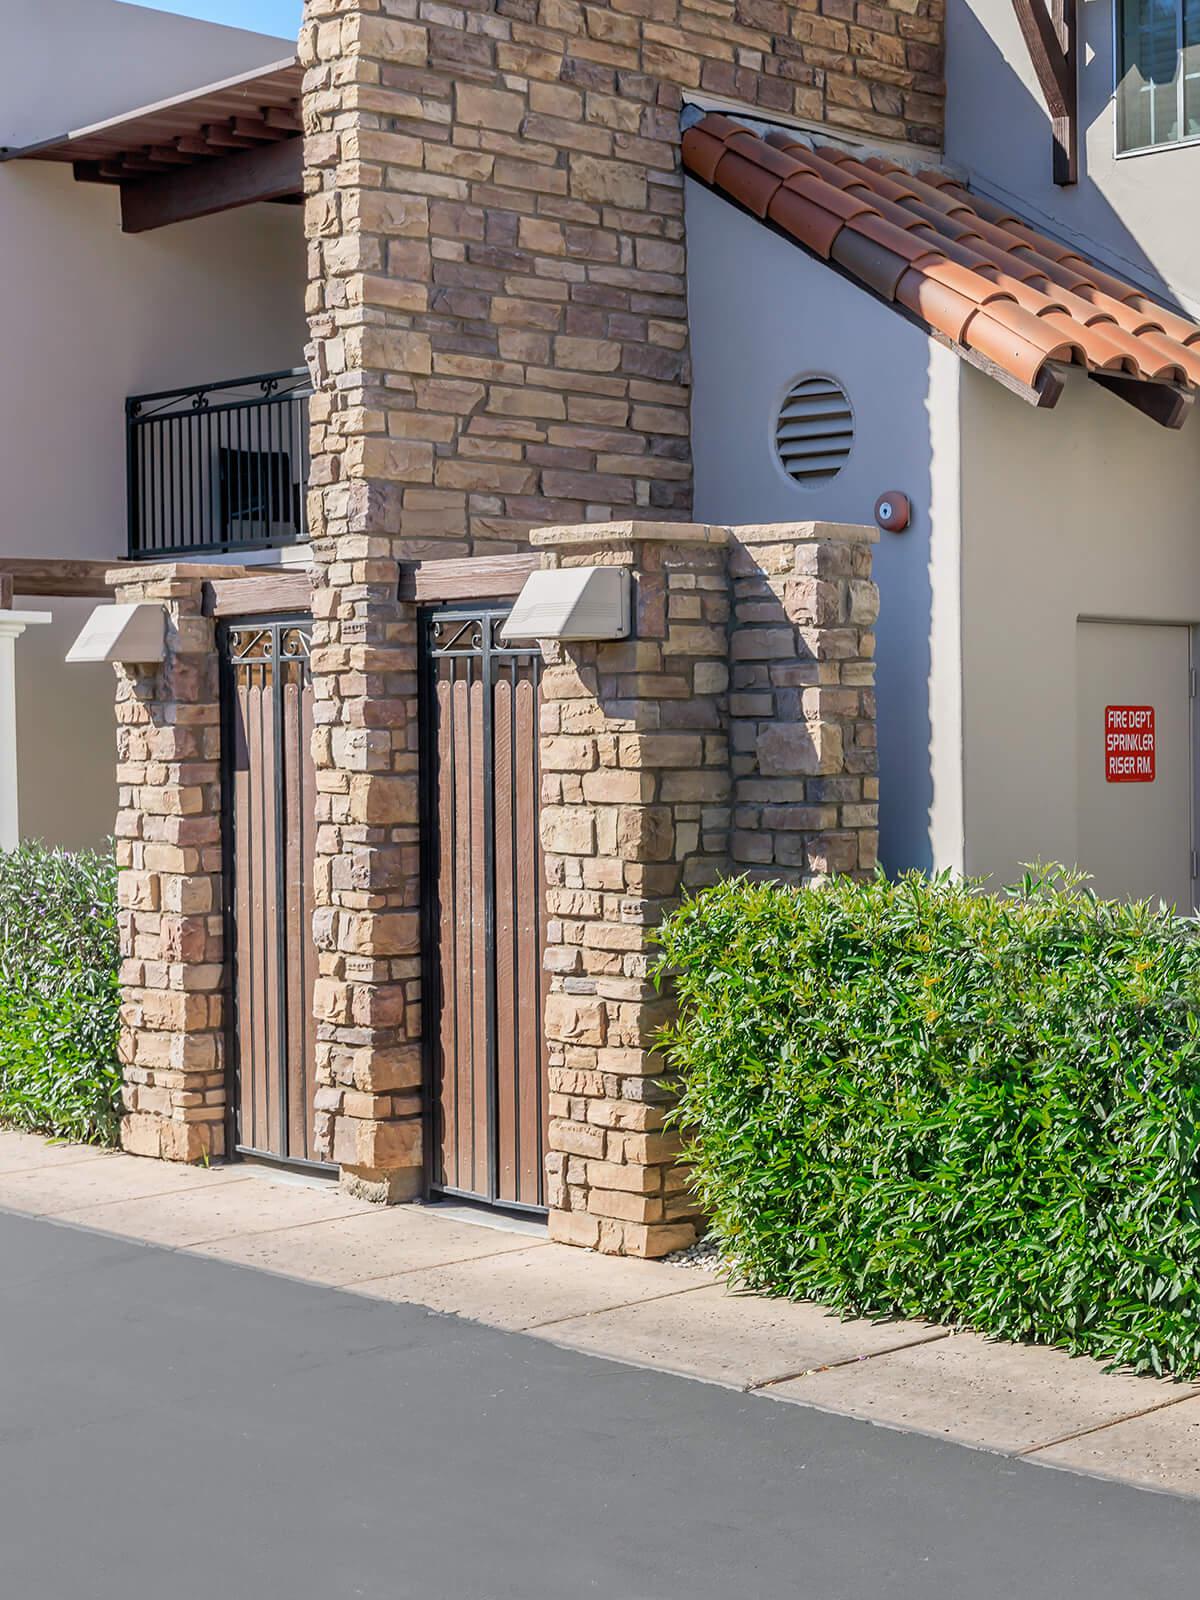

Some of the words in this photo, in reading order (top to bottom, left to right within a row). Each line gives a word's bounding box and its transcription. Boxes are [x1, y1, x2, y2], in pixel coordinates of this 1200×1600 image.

[1108, 711, 1127, 728] FIRE
[1129, 711, 1152, 728] DEPT.
[1107, 734, 1153, 751] SPRINKLER
[1109, 757, 1135, 774] RISER
[1137, 757, 1152, 774] RM.
